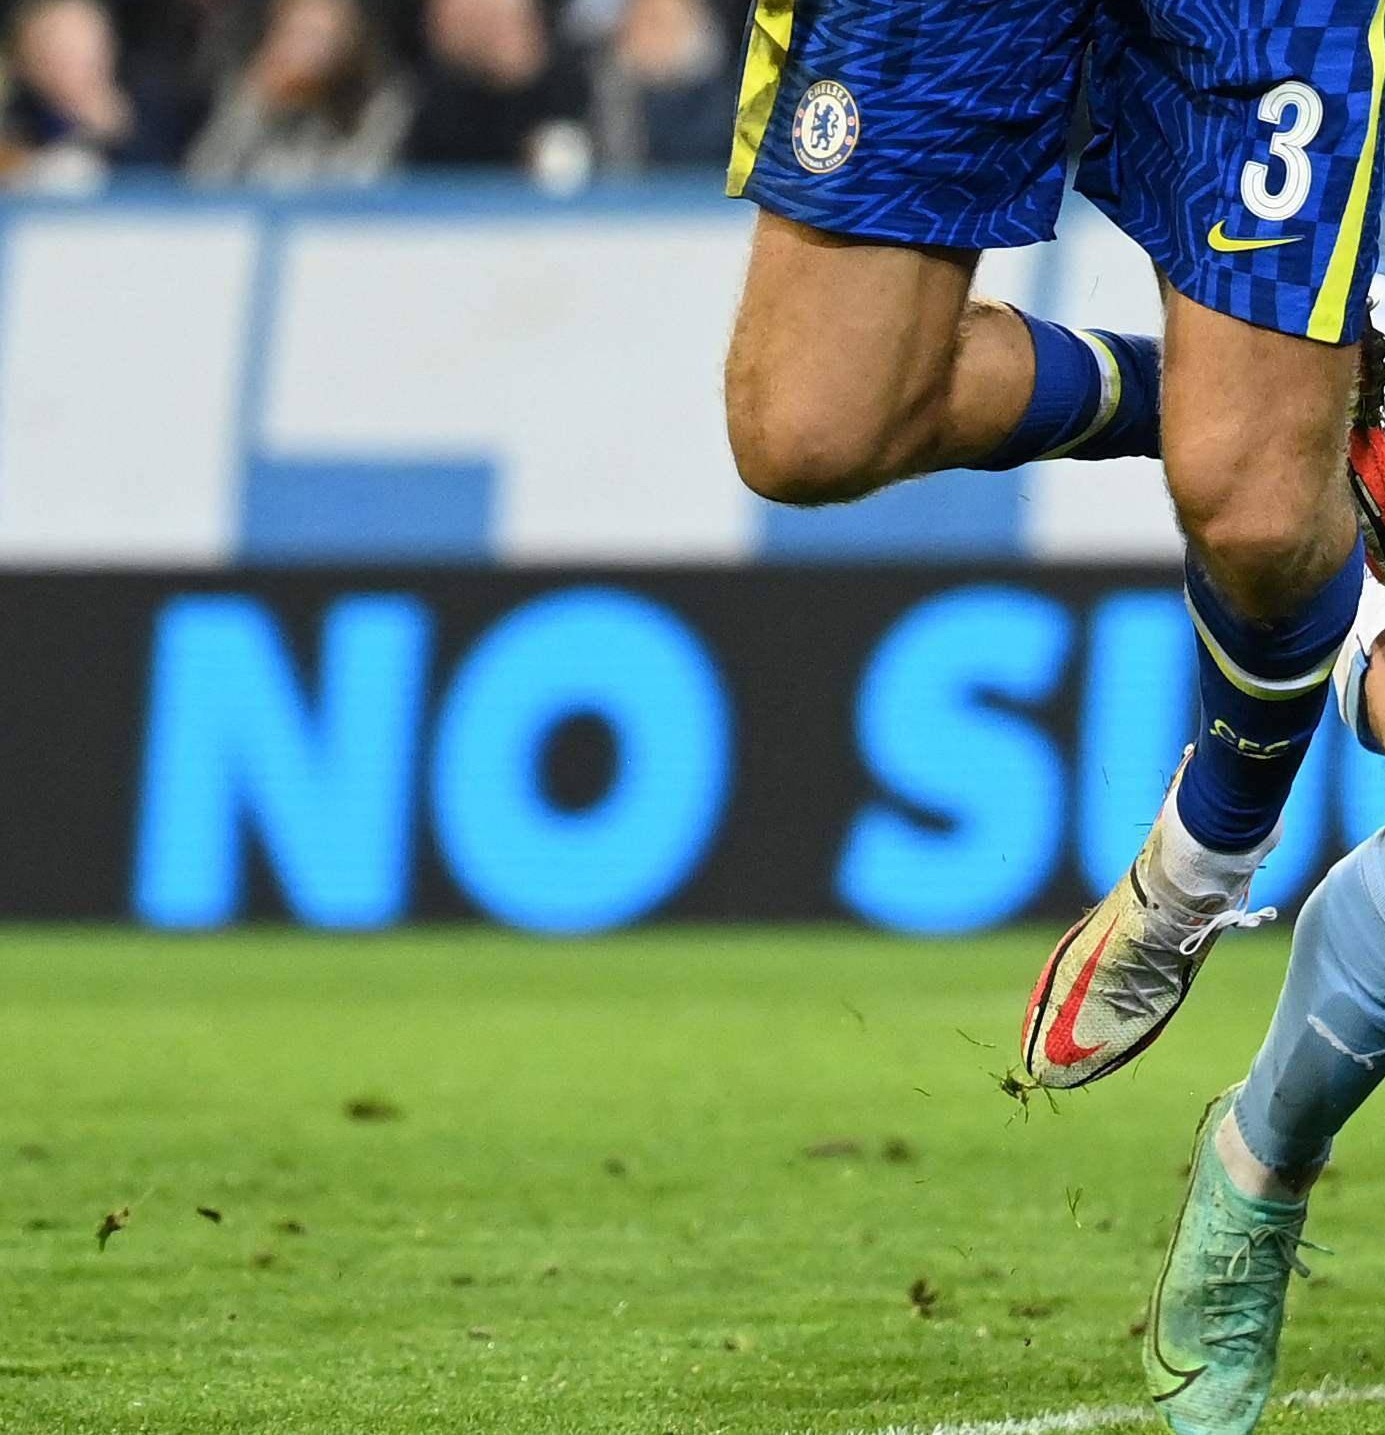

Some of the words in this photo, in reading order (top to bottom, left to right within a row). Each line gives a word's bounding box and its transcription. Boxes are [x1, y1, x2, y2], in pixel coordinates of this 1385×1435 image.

[807, 83, 850, 107] CHELSEA
[1239, 80, 1324, 222] 3
[132, 587, 736, 937] NO
